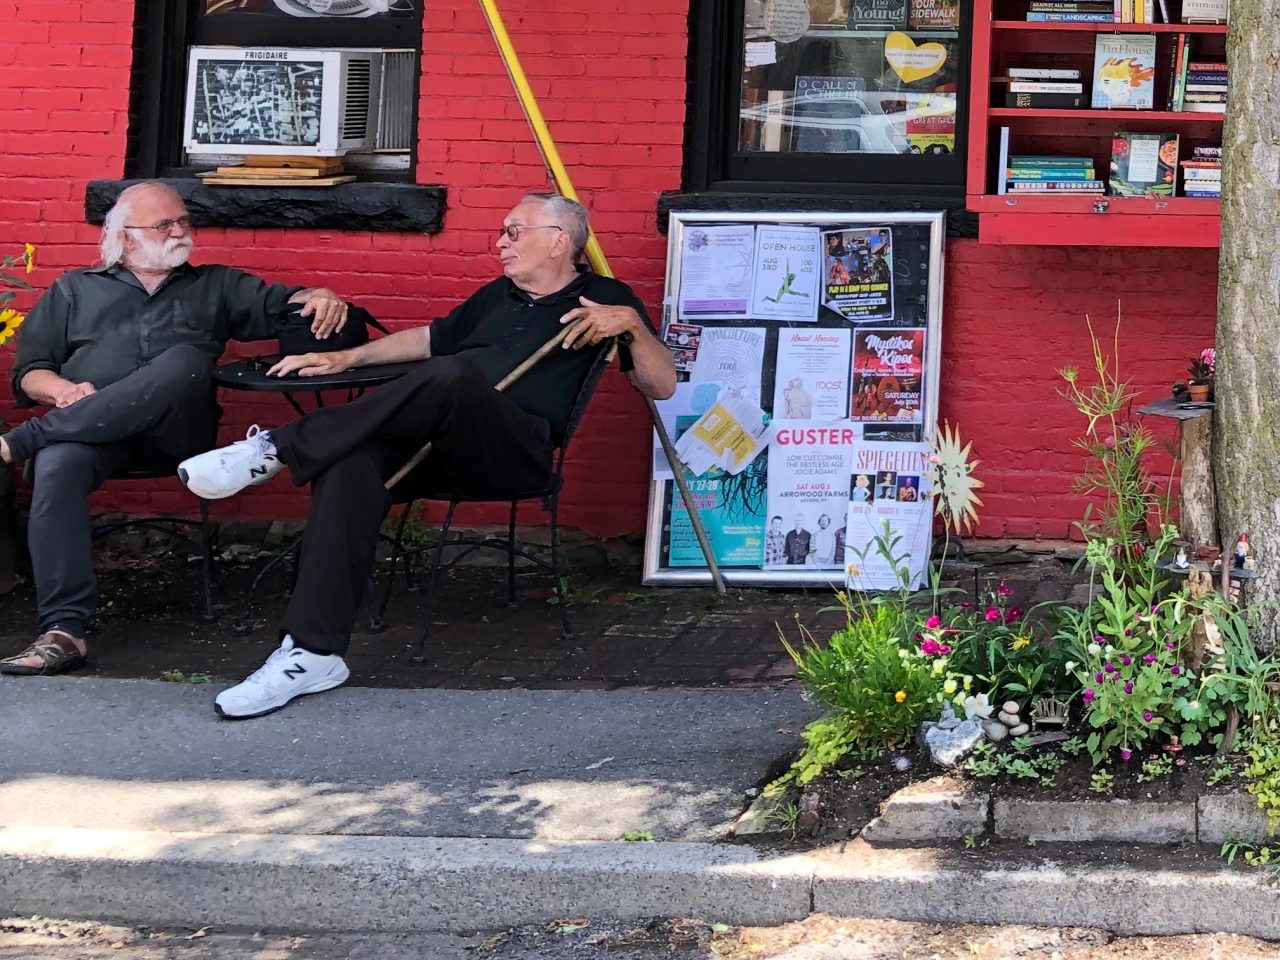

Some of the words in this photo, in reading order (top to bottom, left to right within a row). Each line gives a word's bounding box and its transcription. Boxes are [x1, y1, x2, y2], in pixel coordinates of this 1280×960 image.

[911, 0, 936, 9] YOUR
[1186, 1, 1225, 9] ATTITUDES
[853, 5, 906, 20] Young!
[910, 8, 956, 18] SIDEWALK
[1062, 13, 1106, 21] LANDSCAPING
[1100, 43, 1118, 54] Tin
[1119, 44, 1153, 55] House
[244, 51, 289, 60] FRIGIDAIRE
[811, 80, 844, 90] CALL
[912, 117, 935, 125] GREAT
[937, 116, 957, 124] GALS
[762, 242, 787, 251] OPEN
[788, 243, 816, 253] HOUSE
[762, 257, 778, 265] AUG
[761, 263, 778, 272] 3RD
[700, 328, 763, 349] RMACULTURE
[865, 334, 914, 355] Mystikos
[879, 349, 914, 367] Kipos
[719, 362, 735, 371] YOU
[816, 380, 843, 390] roost
[776, 428, 854, 446] GUSTER
[250, 464, 268, 479] N
[696, 480, 718, 491] 27-28
[778, 490, 824, 498] ARROWOOD
[283, 662, 307, 681] N
